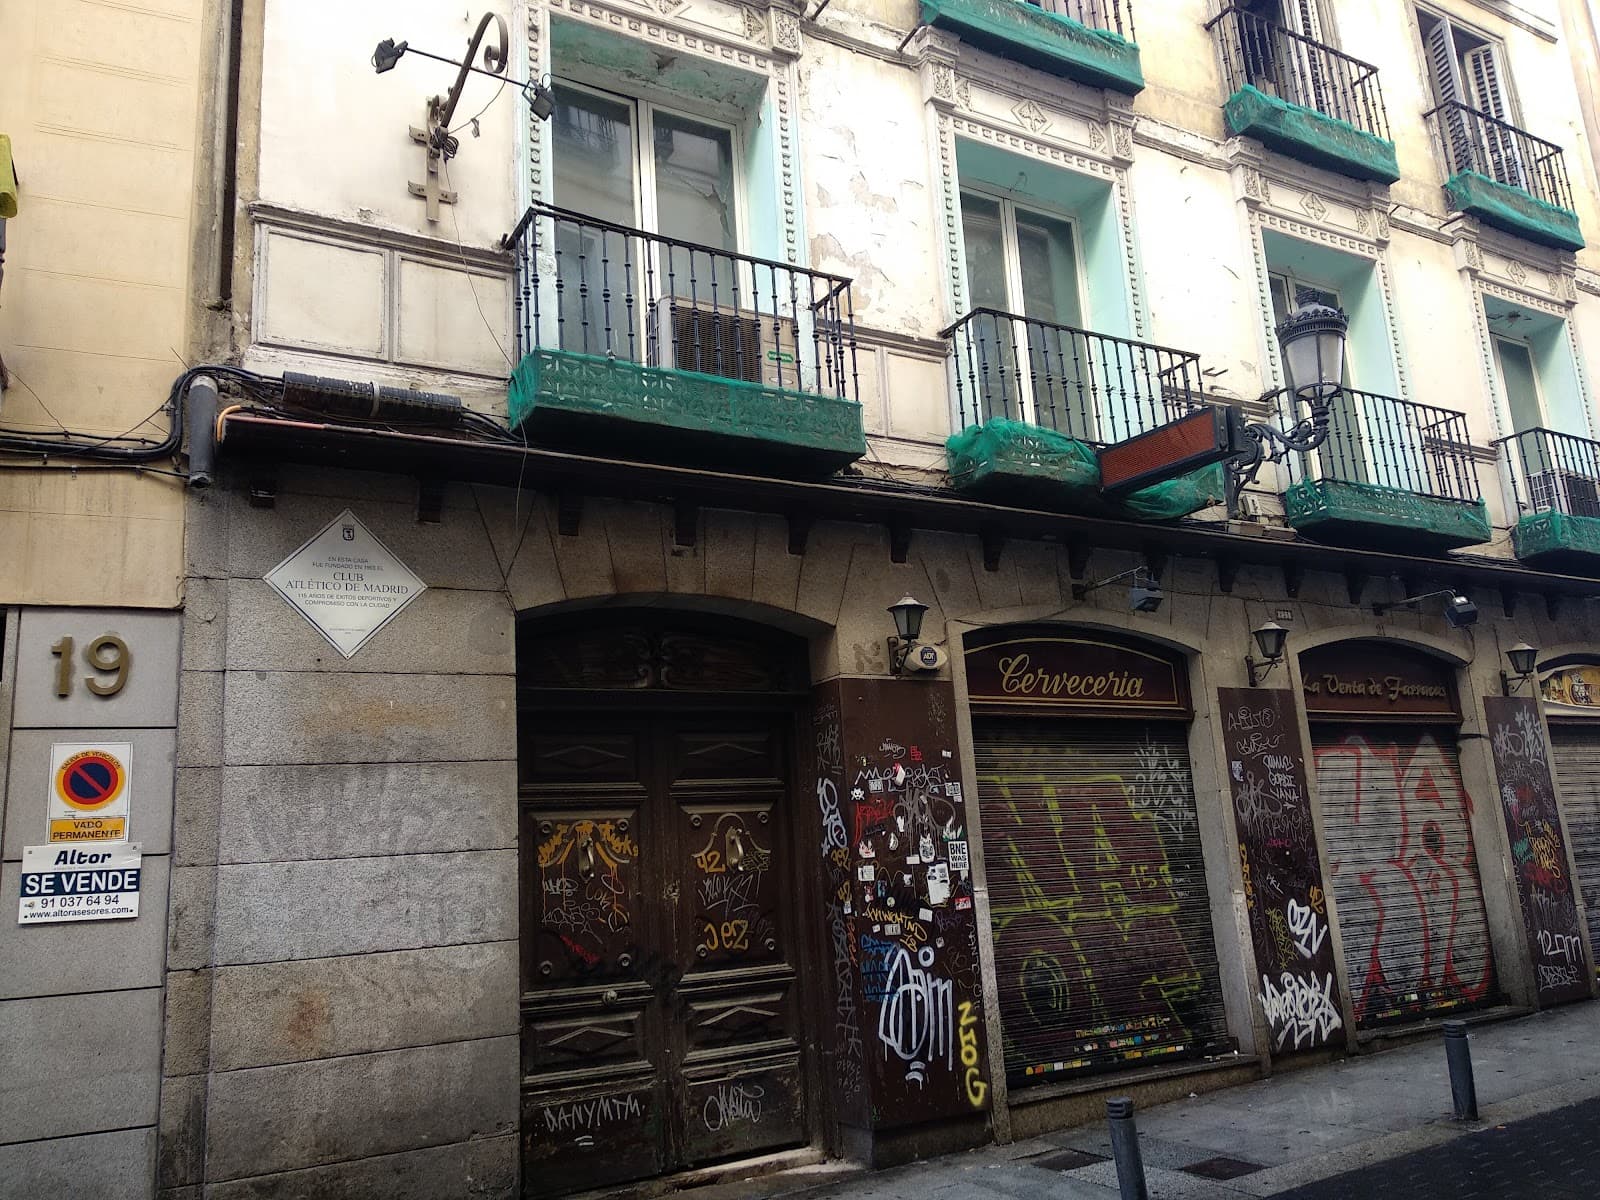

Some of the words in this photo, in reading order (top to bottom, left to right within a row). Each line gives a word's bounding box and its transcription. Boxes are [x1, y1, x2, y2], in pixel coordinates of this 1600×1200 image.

[333, 571, 364, 582] CLUB
[285, 578, 342, 591] ATLÉTICO
[345, 582, 361, 592] DE
[364, 583, 409, 595] MADRID
[304, 599, 345, 607] COMPROMISO
[51, 633, 129, 697] 19
[998, 652, 1145, 698] Cerveceria
[73, 820, 103, 829] VADO
[52, 829, 121, 840] PERMANENTE
[949, 843, 966, 855] BNE
[54, 849, 112, 866] Altor
[25, 873, 56, 895] SE
[61, 870, 138, 893] VENDE
[41, 898, 55, 909] 91
[60, 896, 83, 908] 037
[86, 896, 102, 906] 64
[104, 894, 120, 906] 94
[29, 906, 129, 919] www.altorasesores.com
